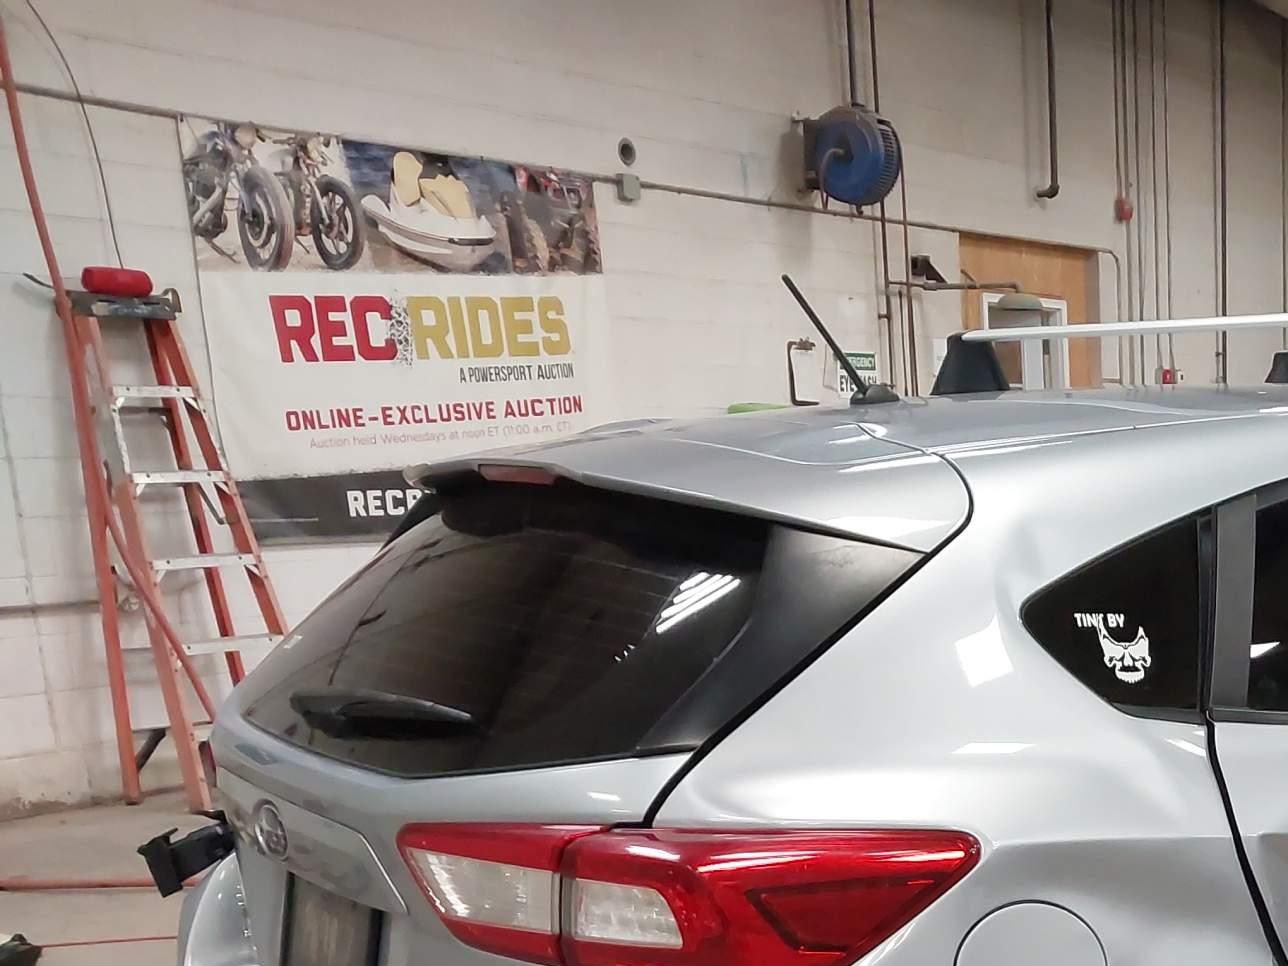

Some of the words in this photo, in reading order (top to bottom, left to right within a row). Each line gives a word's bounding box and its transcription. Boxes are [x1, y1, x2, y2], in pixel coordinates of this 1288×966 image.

[269, 295, 399, 362] REC
[406, 295, 572, 361] RIDES
[459, 366, 467, 383] A
[468, 364, 533, 382] POWERSPORT
[537, 362, 575, 380] AUCTION
[285, 401, 497, 431] ONLINE-EXCLUSIVE
[503, 394, 583, 418] AUCTION
[310, 437, 351, 449] Auction
[352, 433, 377, 446] held
[380, 428, 446, 443] Wednesdays
[448, 430, 459, 440] at
[461, 428, 486, 440] noon
[486, 426, 499, 438] ET
[1106, 612, 1125, 628] BY
